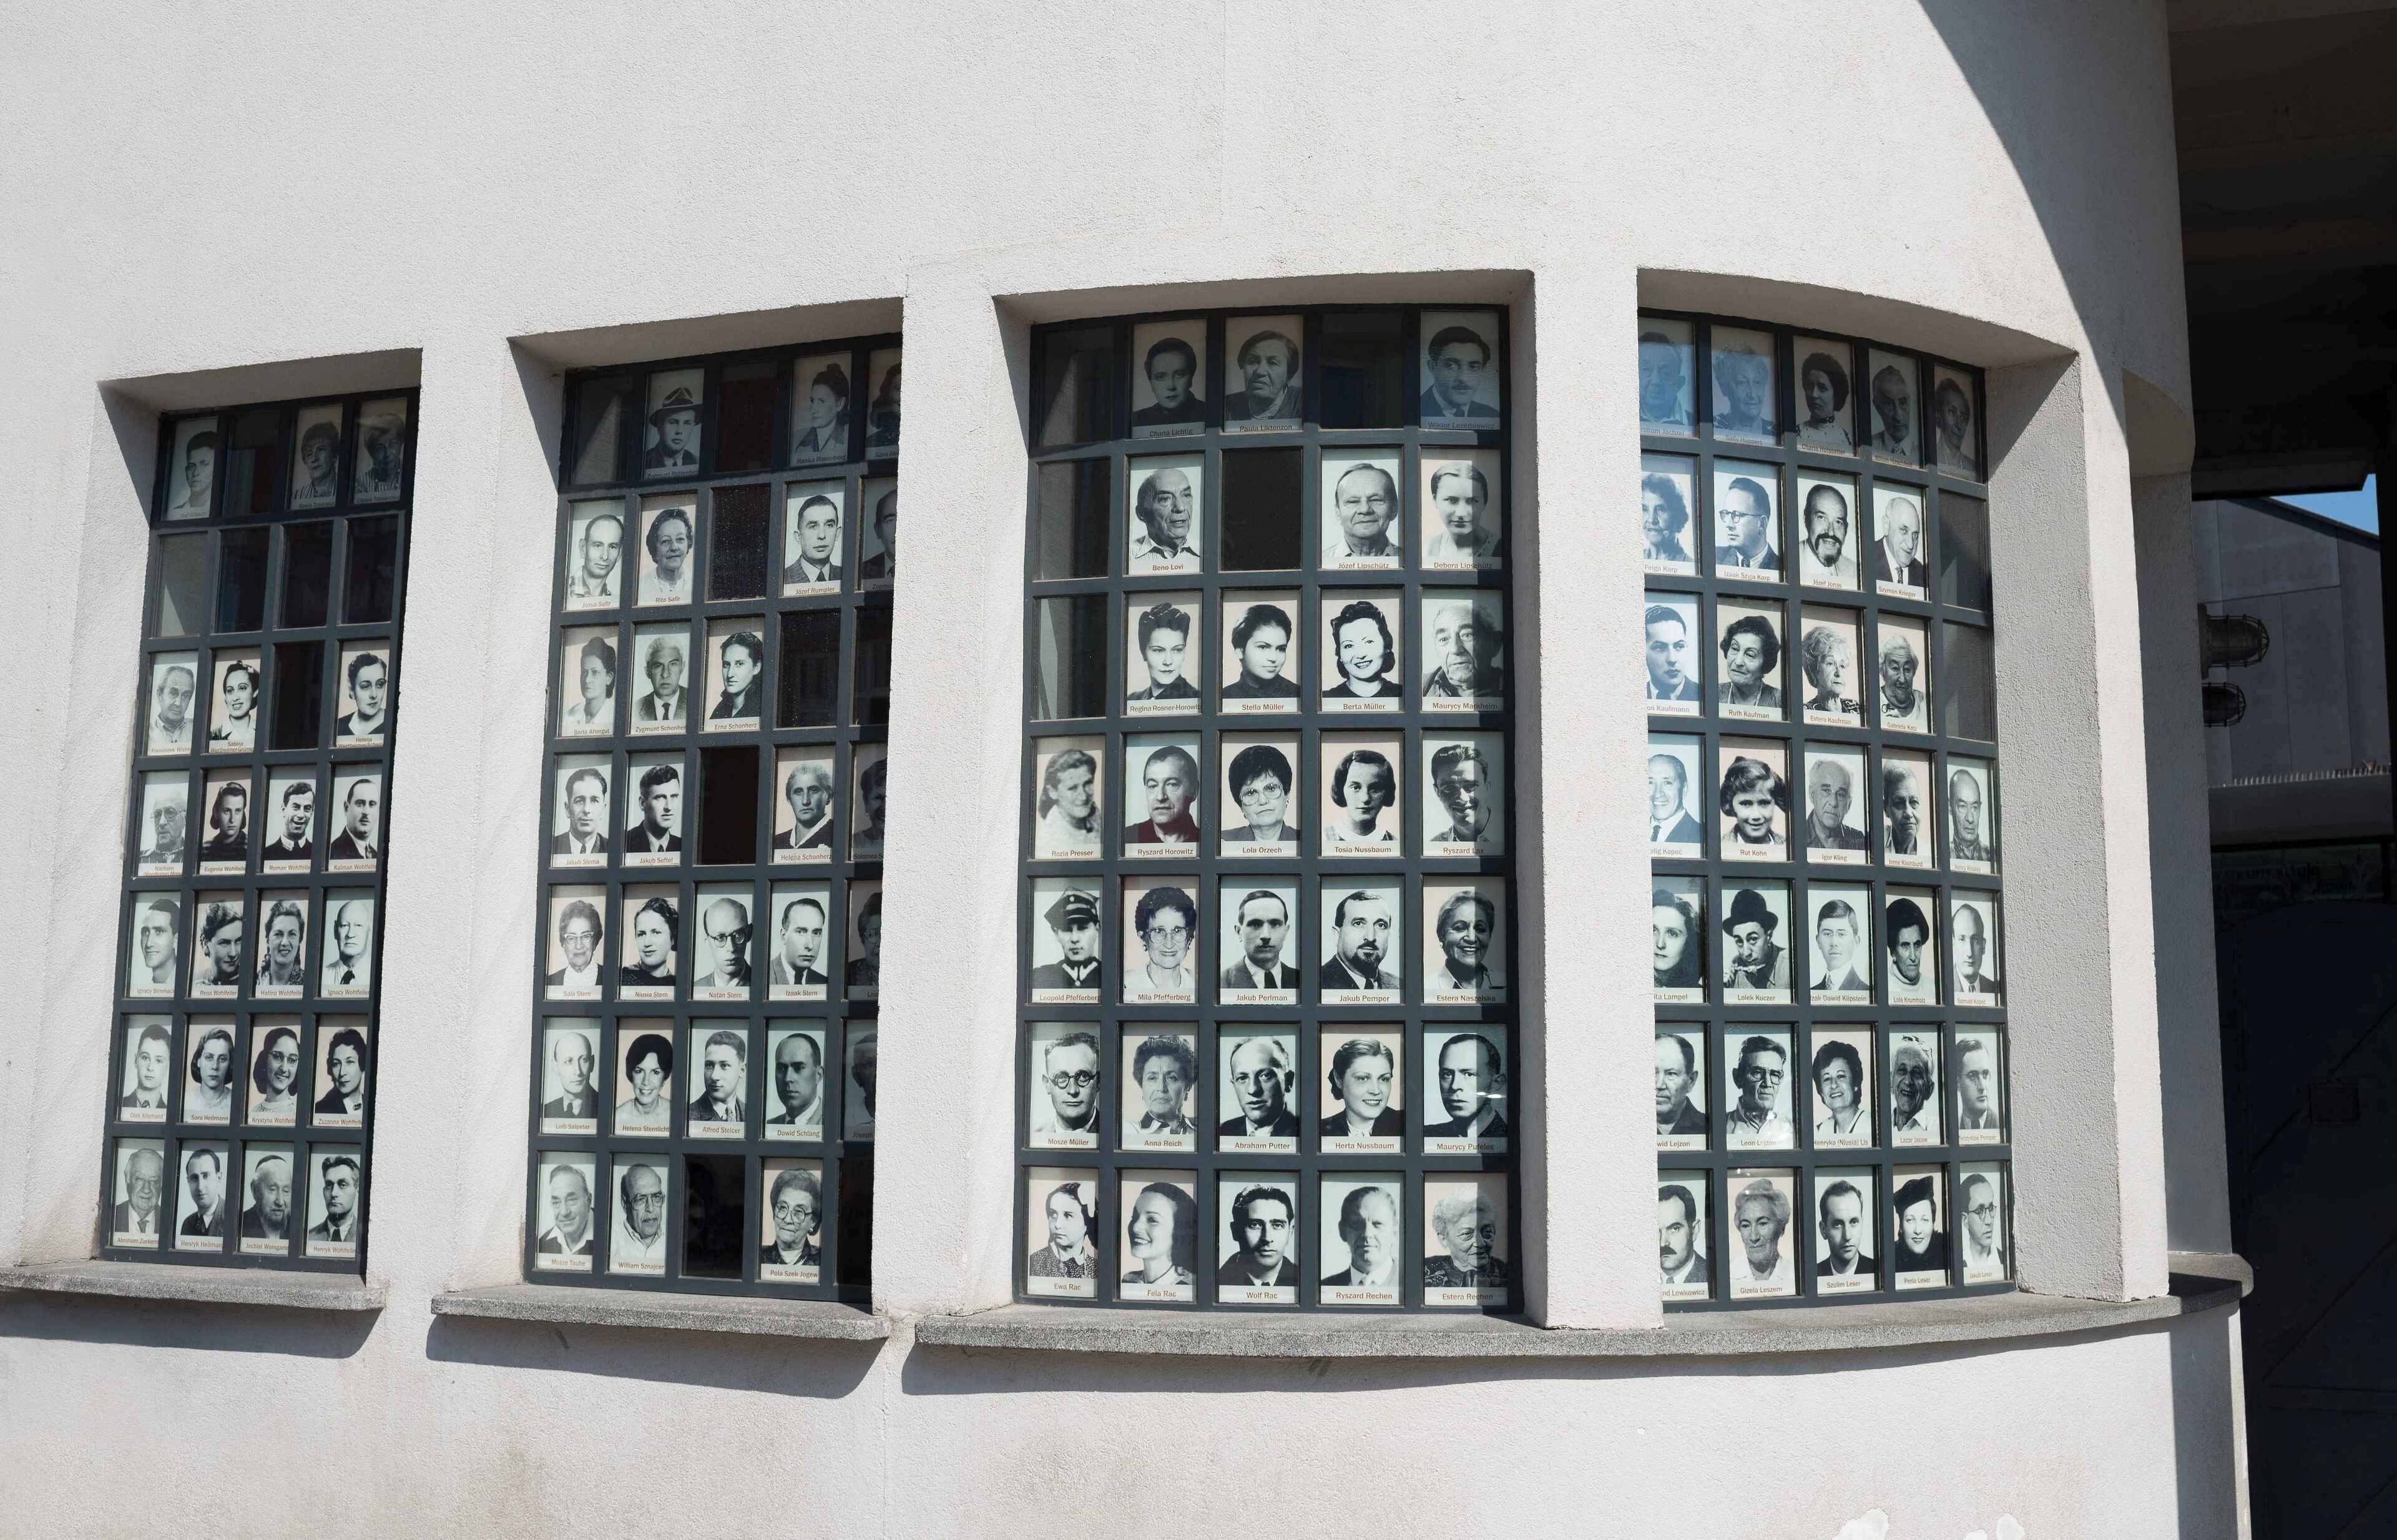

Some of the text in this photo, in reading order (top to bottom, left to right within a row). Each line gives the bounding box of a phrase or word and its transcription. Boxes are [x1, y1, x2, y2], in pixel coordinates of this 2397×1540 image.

[1130, 703, 1200, 714] Regina Rosner-Horowit
[1433, 702, 1461, 711] Maurycy
[1743, 710, 1770, 719] Kaufman
[1138, 848, 1163, 856] Ryszard
[1443, 847, 1470, 855] Ryszard
[1833, 855, 1847, 863] Kling
[1154, 993, 1190, 1002] Pfefferberg
[1363, 995, 1389, 1003] Pemper
[1069, 1137, 1089, 1146] Müller
[1437, 1142, 1466, 1151] Maurycy
[1336, 1292, 1363, 1300] Ryszard
